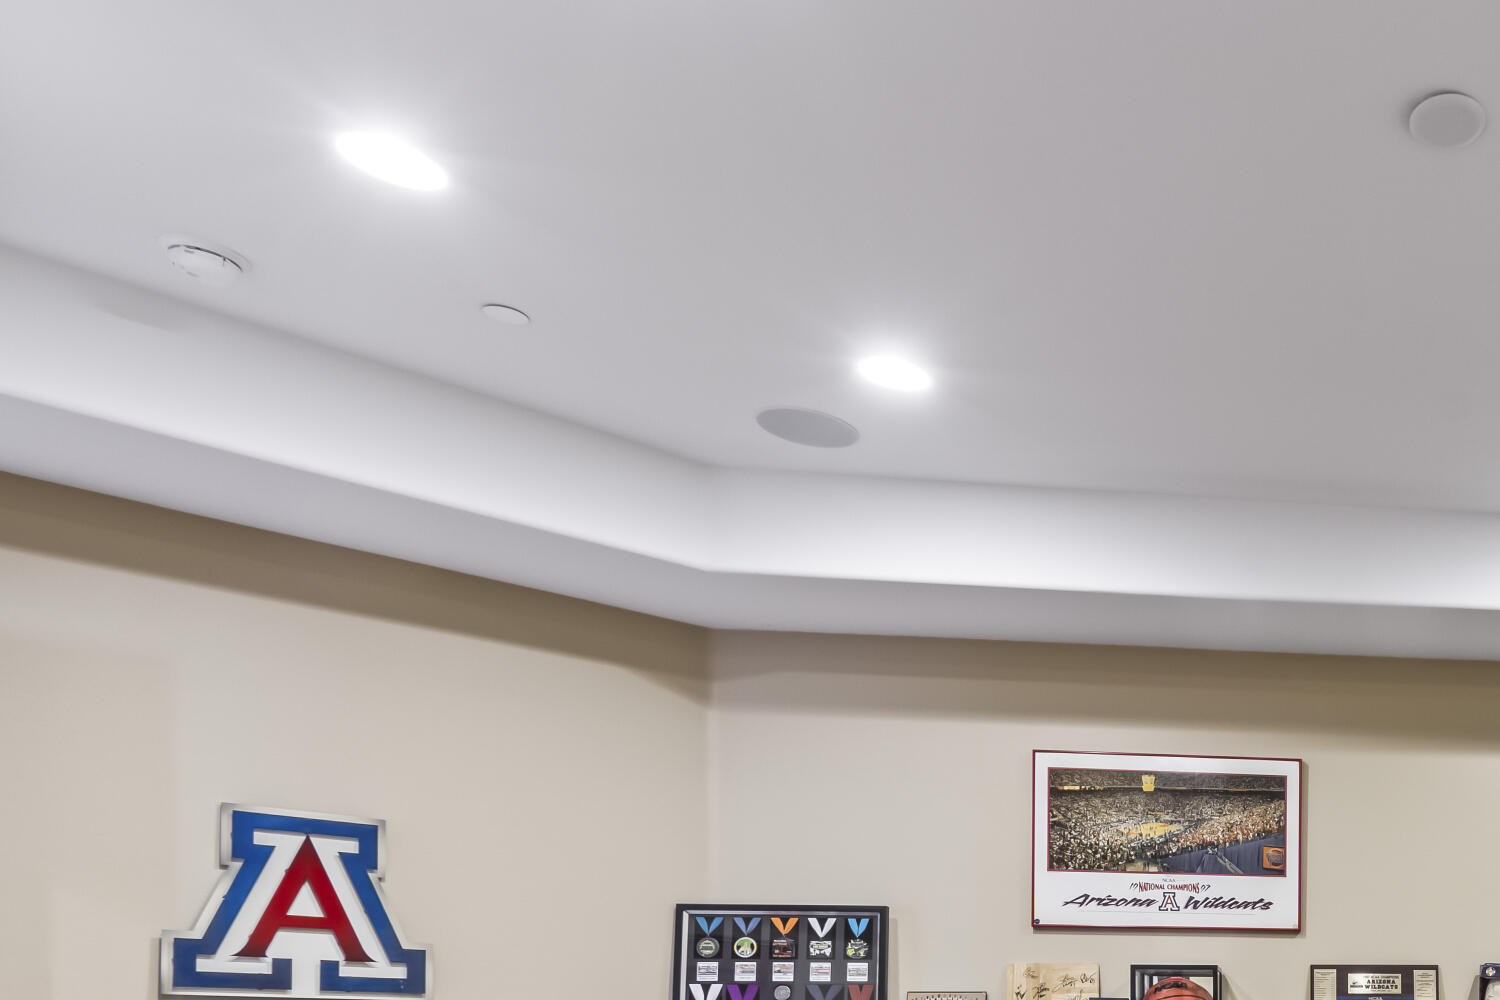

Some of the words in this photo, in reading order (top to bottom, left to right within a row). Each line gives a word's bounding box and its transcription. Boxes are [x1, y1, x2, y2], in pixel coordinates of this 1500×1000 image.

[1139, 881, 1165, 893] NATIONAL
[1166, 882, 1200, 894] CHAMPIONS
[162, 803, 432, 1000] A
[1062, 893, 1159, 908] Arizona
[1158, 892, 1180, 911] A
[1183, 895, 1274, 910] Wildcats
